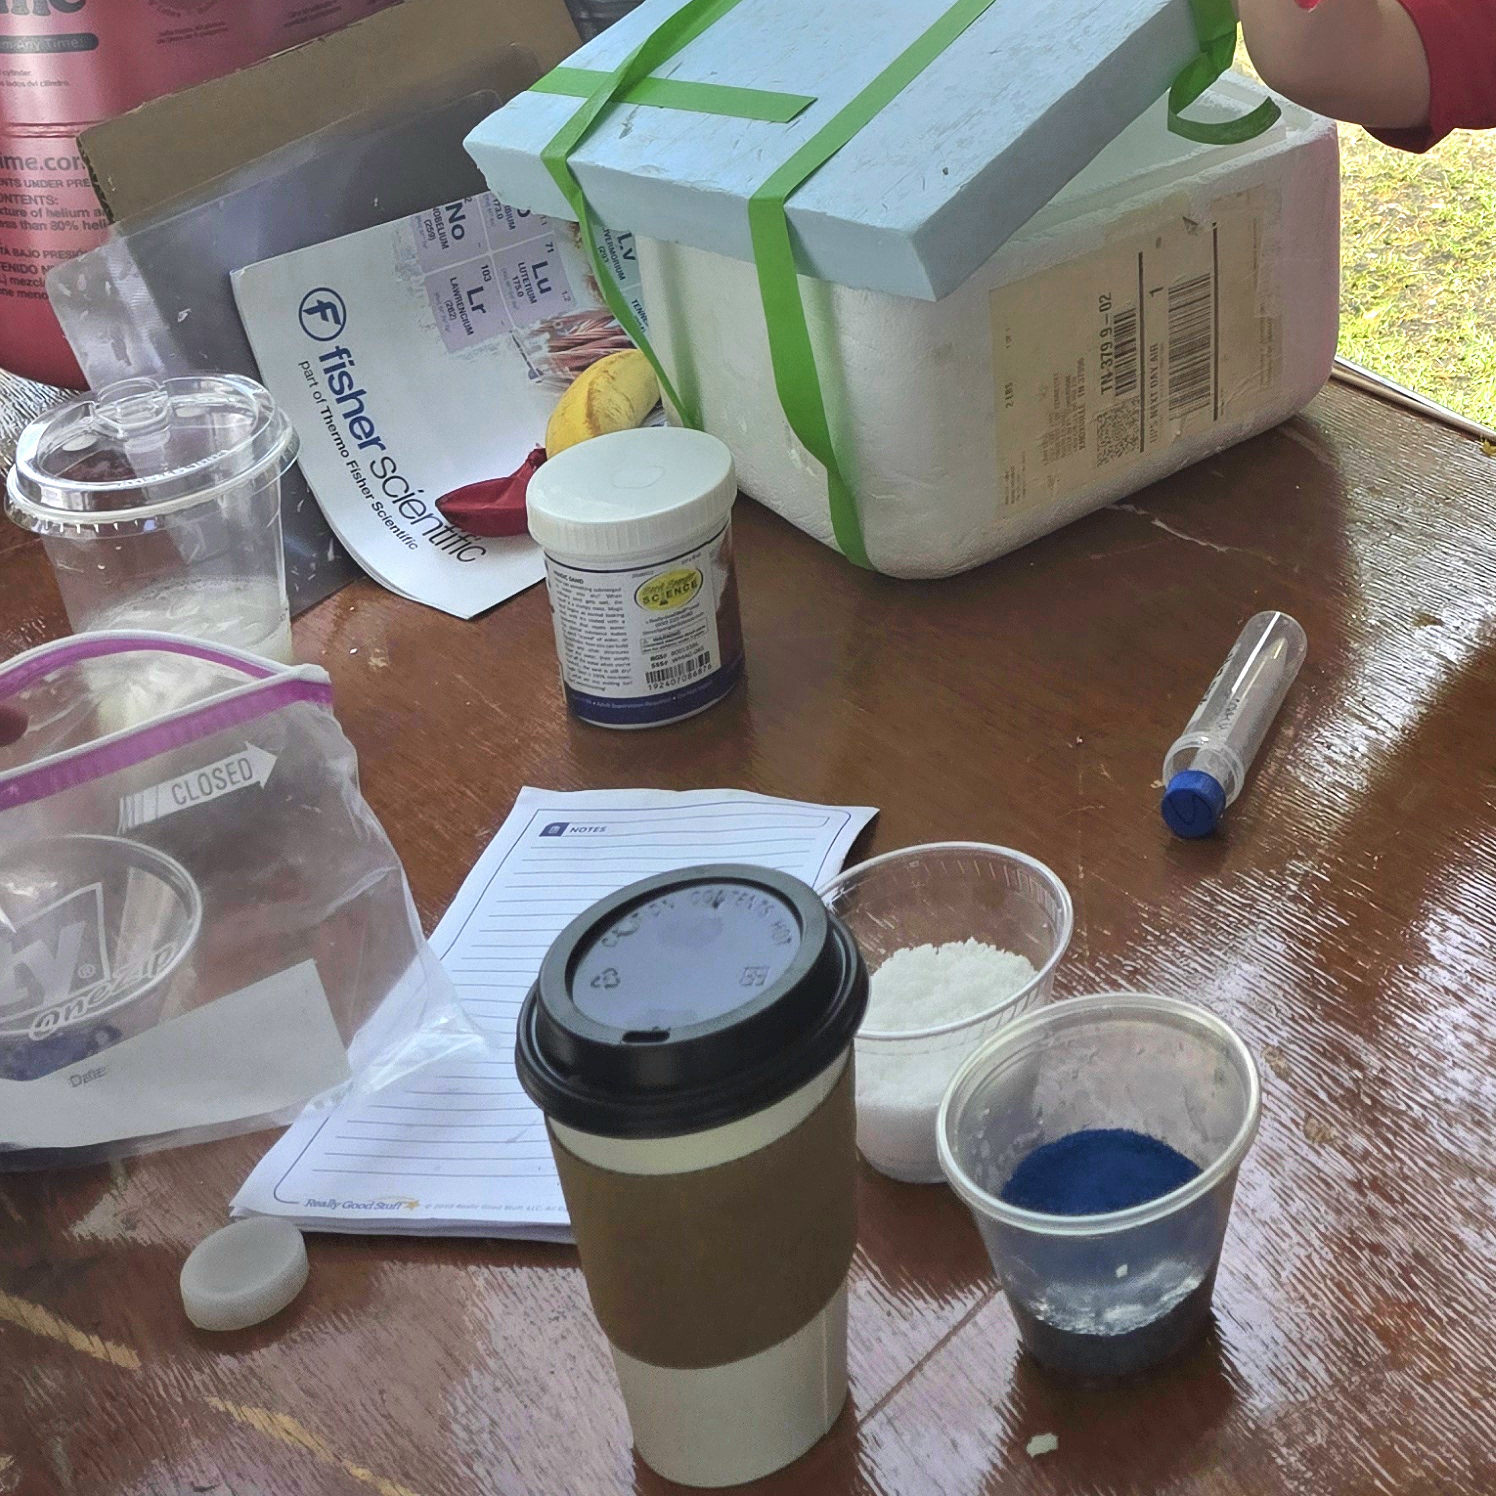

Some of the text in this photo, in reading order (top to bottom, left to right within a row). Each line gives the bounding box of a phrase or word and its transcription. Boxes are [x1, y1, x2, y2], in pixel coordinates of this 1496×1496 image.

[444, 201, 466, 242] No
[480, 264, 493, 283] 103
[602, 227, 628, 282] IVERMORIUM
[512, 275, 525, 299] 175.0
[517, 261, 538, 305] LUTETIUM
[531, 260, 553, 295] Lu
[450, 276, 475, 337] LAWRENCIUM
[466, 285, 488, 316] Lr
[298, 360, 419, 552] part of Thermo Fisher Scientific
[319, 345, 487, 564] fisher scientific
[642, 578, 699, 605] SCIENCE
[171, 757, 254, 806] CLOSED
[569, 825, 607, 834] NOTES
[304, 1197, 342, 1211] Really
[342, 1199, 374, 1210] Good
